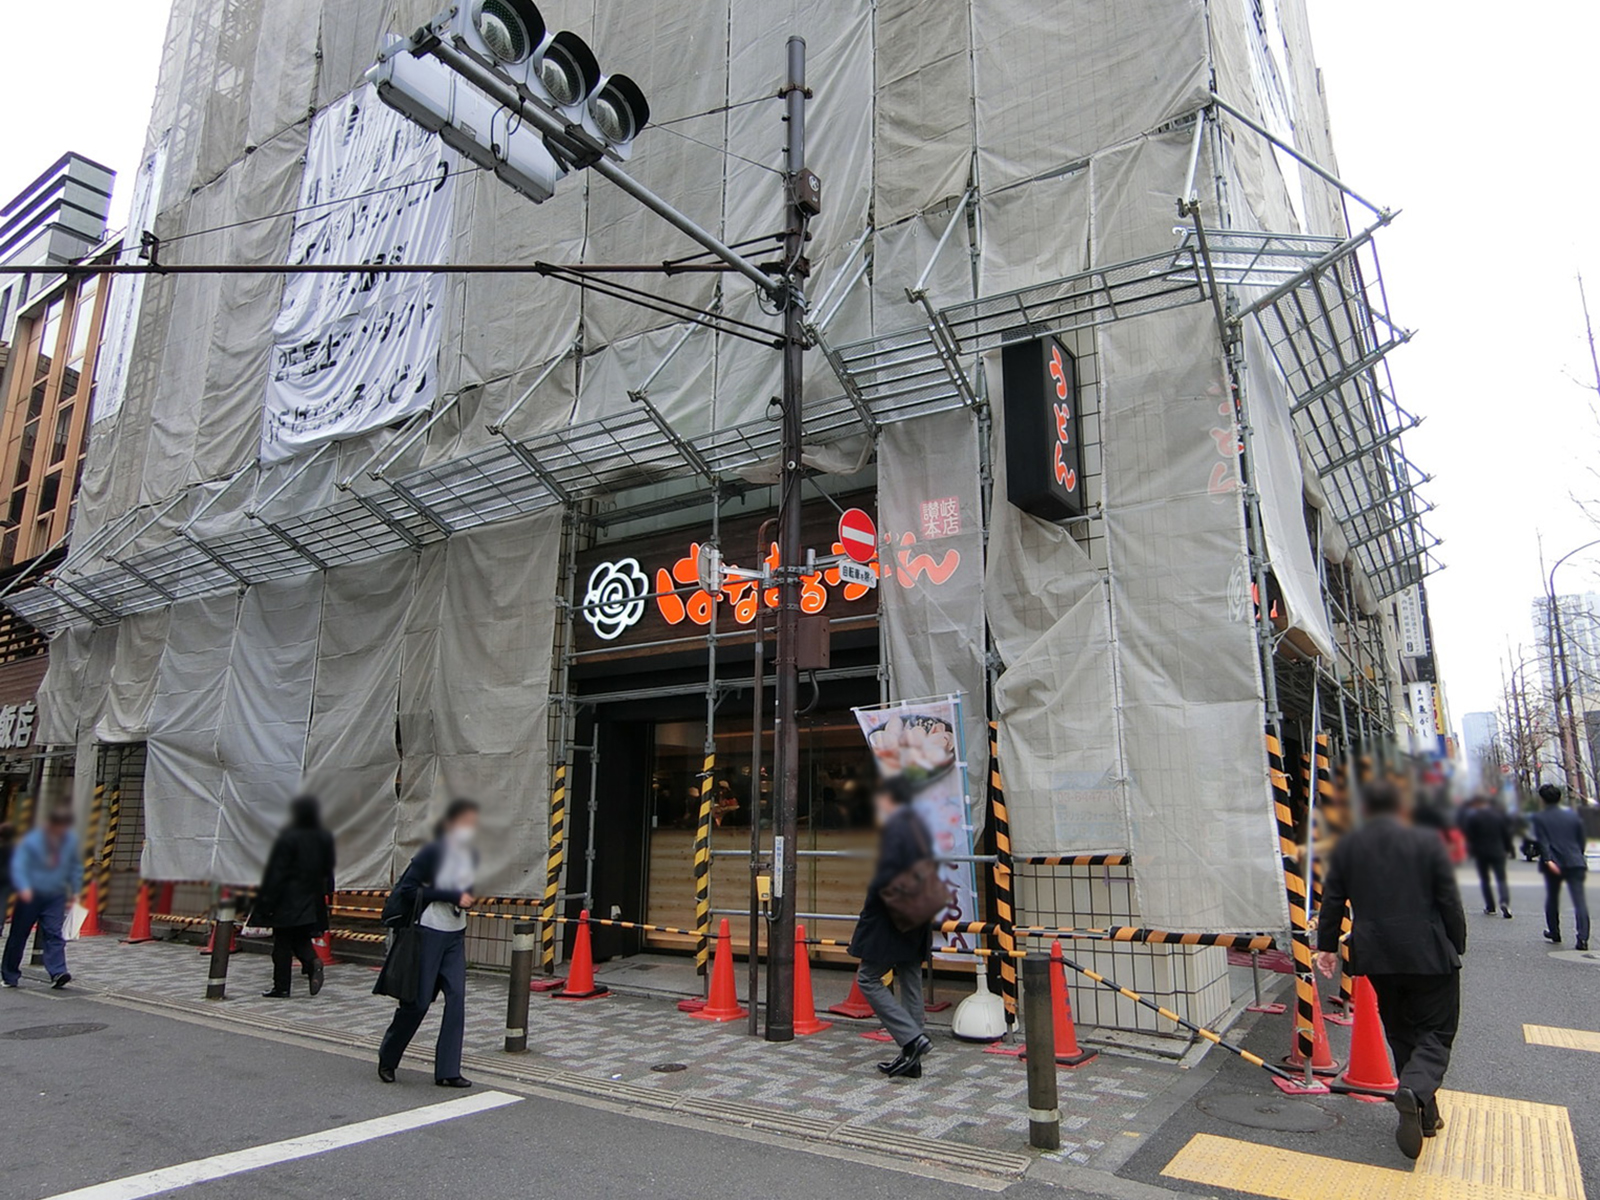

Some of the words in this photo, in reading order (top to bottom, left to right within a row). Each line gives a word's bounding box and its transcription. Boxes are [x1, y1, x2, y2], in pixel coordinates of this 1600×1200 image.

[1050, 346, 1076, 492] うどん
[922, 498, 958, 521] 讃岐
[924, 517, 960, 538] 本店
[656, 531, 960, 625] はなるん
[842, 565, 875, 584] 自転車を除く
